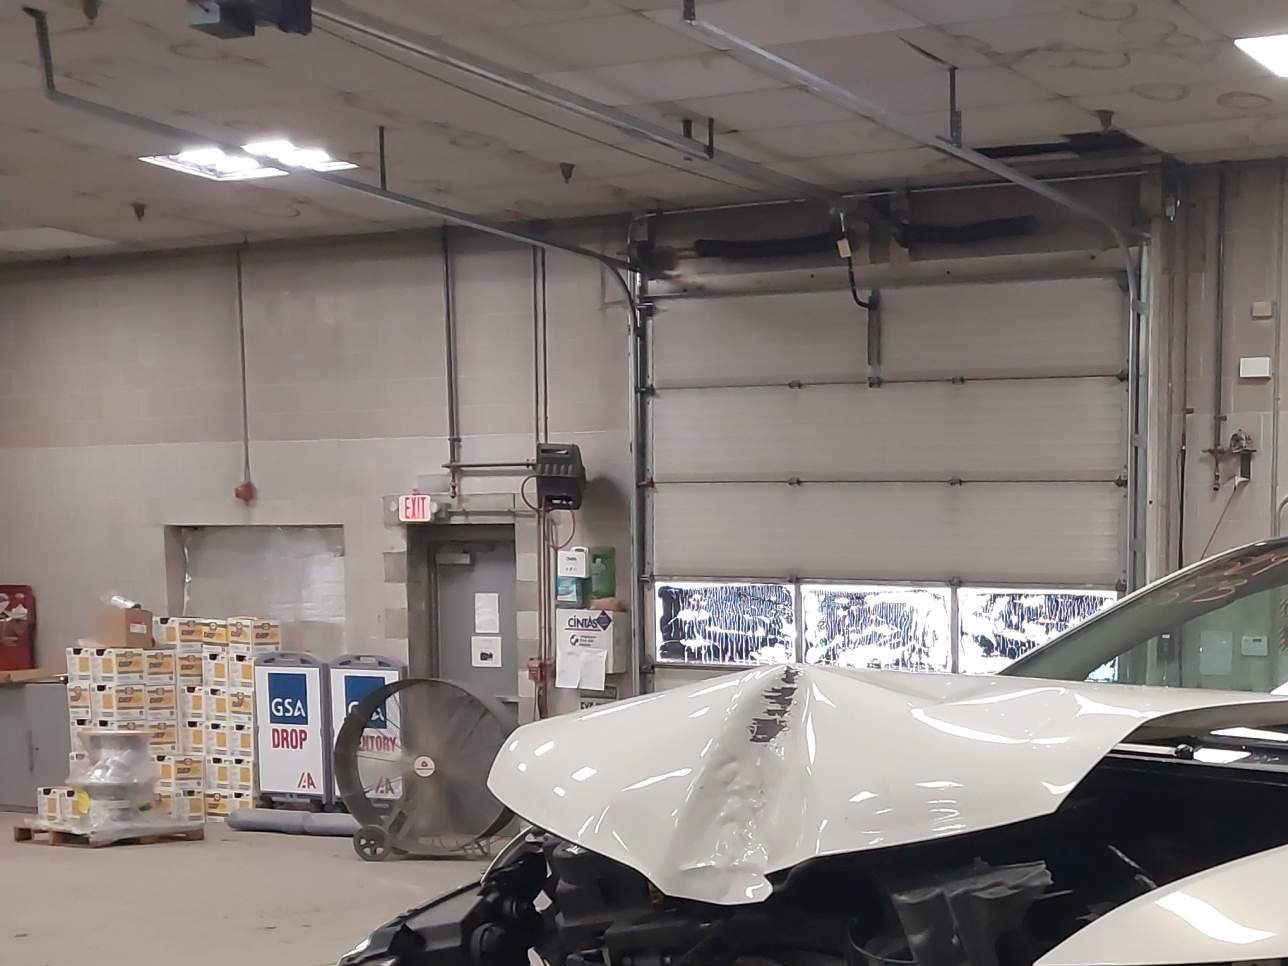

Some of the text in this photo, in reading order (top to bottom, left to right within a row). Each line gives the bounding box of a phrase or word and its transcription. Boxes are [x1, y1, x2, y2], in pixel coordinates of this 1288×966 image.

[404, 496, 427, 519] EXIT
[271, 698, 306, 717] GSA
[271, 728, 308, 750] DROP
